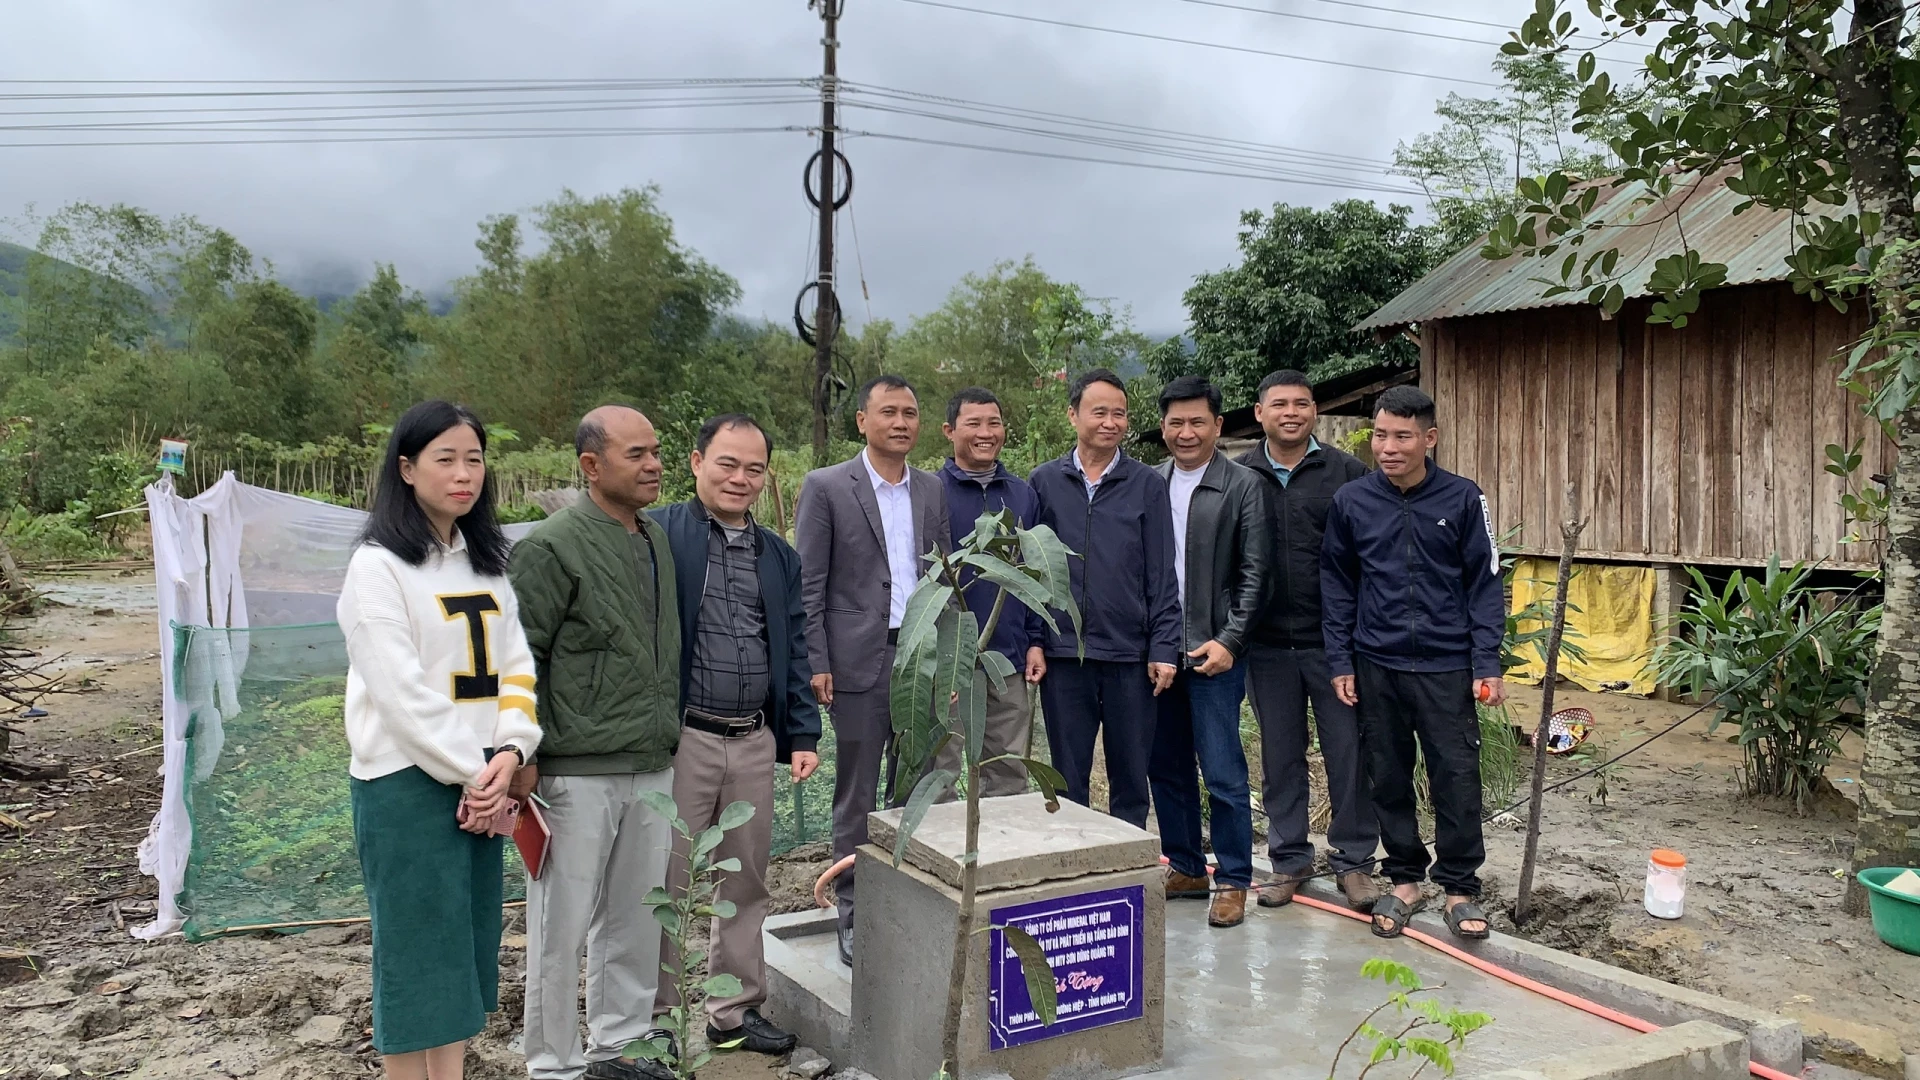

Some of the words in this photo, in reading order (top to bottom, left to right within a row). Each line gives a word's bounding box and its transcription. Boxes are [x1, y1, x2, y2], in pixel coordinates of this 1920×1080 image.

[435, 590, 501, 704] I
[1040, 922, 1045, 935] TY
[1067, 914, 1089, 930] MINERAL
[1088, 911, 1099, 927] VIỆT
[1099, 911, 1111, 924] NAM
[1059, 933, 1072, 949] PHÁT
[1106, 944, 1115, 959] TRỊ
[1117, 991, 1126, 1003] TRỊ
